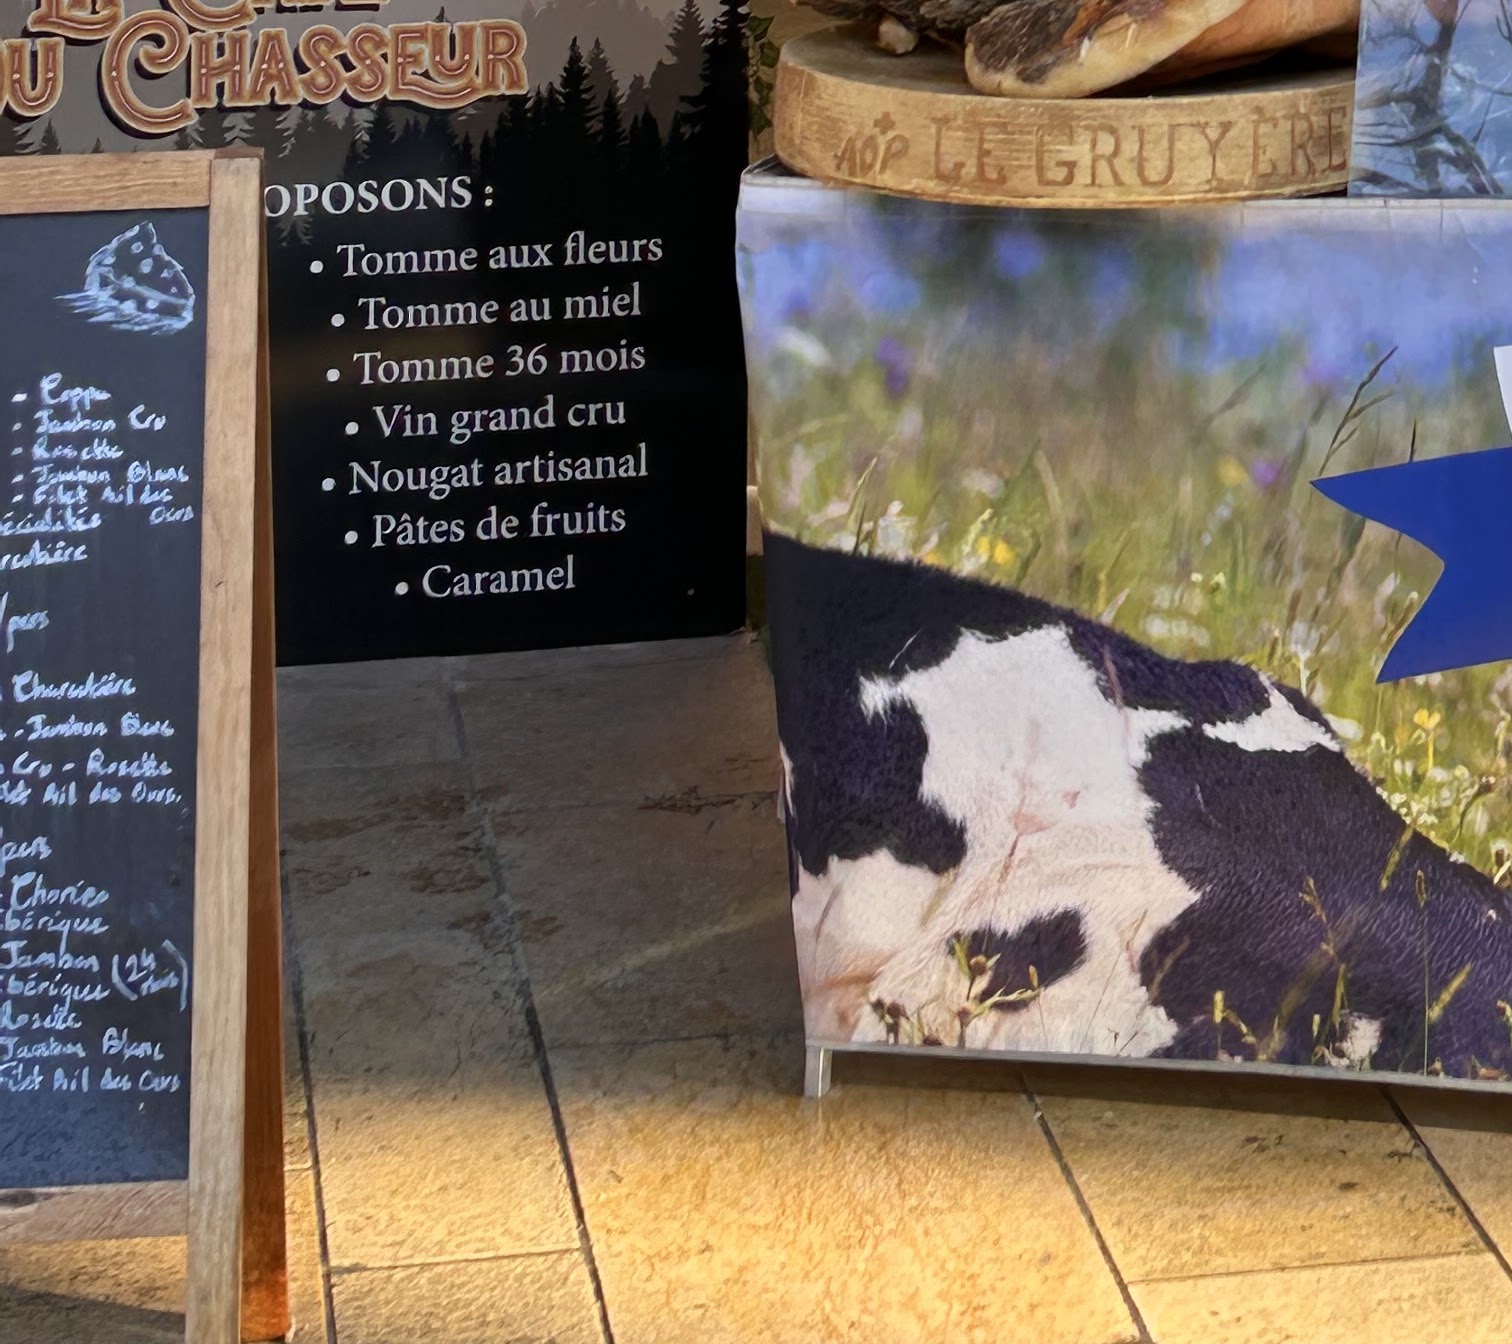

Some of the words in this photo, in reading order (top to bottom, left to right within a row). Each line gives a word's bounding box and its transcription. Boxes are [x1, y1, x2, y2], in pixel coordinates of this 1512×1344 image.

[0, 38, 64, 117] U
[101, 10, 529, 135] CHASSEUR
[932, 117, 1007, 185] LE
[337, 243, 477, 277] Tomme
[488, 241, 553, 268] aux
[563, 230, 663, 265] fleurs
[358, 297, 499, 330] Tomme
[509, 295, 551, 321] au
[565, 282, 641, 318] miel
[353, 351, 494, 385] Tomme
[505, 344, 548, 376] 36
[559, 340, 646, 374] mois
[373, 404, 438, 438] Vin
[449, 394, 556, 444] grand
[567, 400, 626, 428] cru
[349, 459, 484, 500] Nougat
[494, 442, 648, 486] artisanal
[372, 511, 465, 548] Pâtes
[476, 505, 519, 541] de
[530, 501, 626, 537] fruits
[422, 554, 576, 597] Caramel
